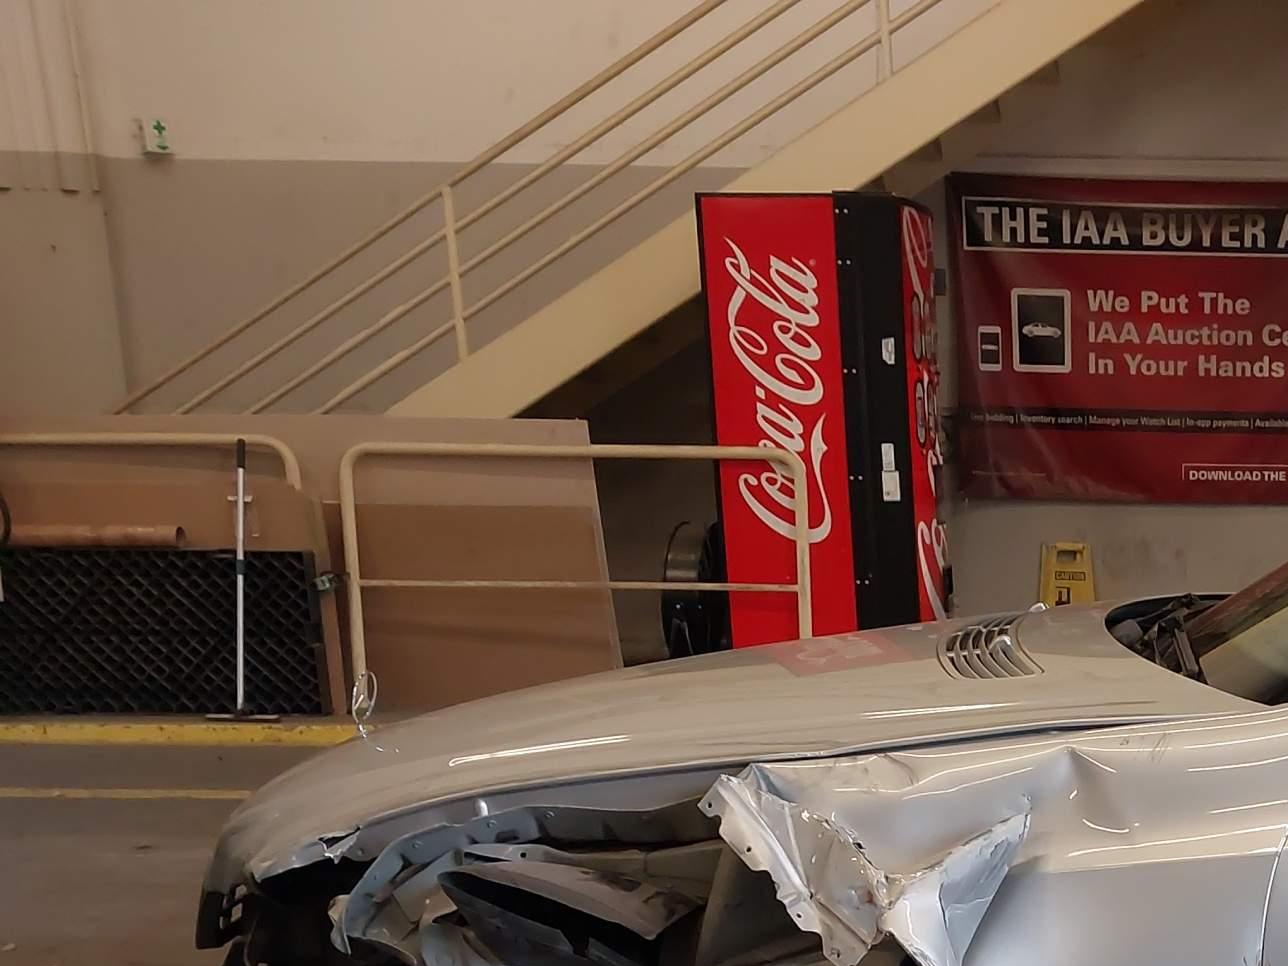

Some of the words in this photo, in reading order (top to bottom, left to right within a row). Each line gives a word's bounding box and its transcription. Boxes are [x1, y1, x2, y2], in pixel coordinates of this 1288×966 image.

[977, 207, 1049, 242] THE
[1062, 209, 1130, 245] IAA
[1142, 213, 1266, 248] BUYER
[1087, 290, 1130, 313] We
[1140, 291, 1188, 314] Put
[1199, 292, 1251, 315] The
[1088, 322, 1140, 344] IAA
[1147, 323, 1253, 346] Auction
[1088, 353, 1117, 375] In
[1123, 353, 1189, 376] Your
[1199, 355, 1286, 378] Hands
[1020, 414, 1056, 424] Inventory
[1058, 415, 1083, 424] search
[1089, 416, 1121, 426] Manage
[1122, 417, 1138, 426] your
[1140, 417, 1165, 426] Watch
[1167, 417, 1181, 426] List
[1186, 418, 1211, 427] In-app
[1213, 419, 1249, 429] payments
[1255, 419, 1288, 428] Available
[1189, 470, 1261, 482] DOWNLOAD
[1262, 471, 1287, 482] THE
